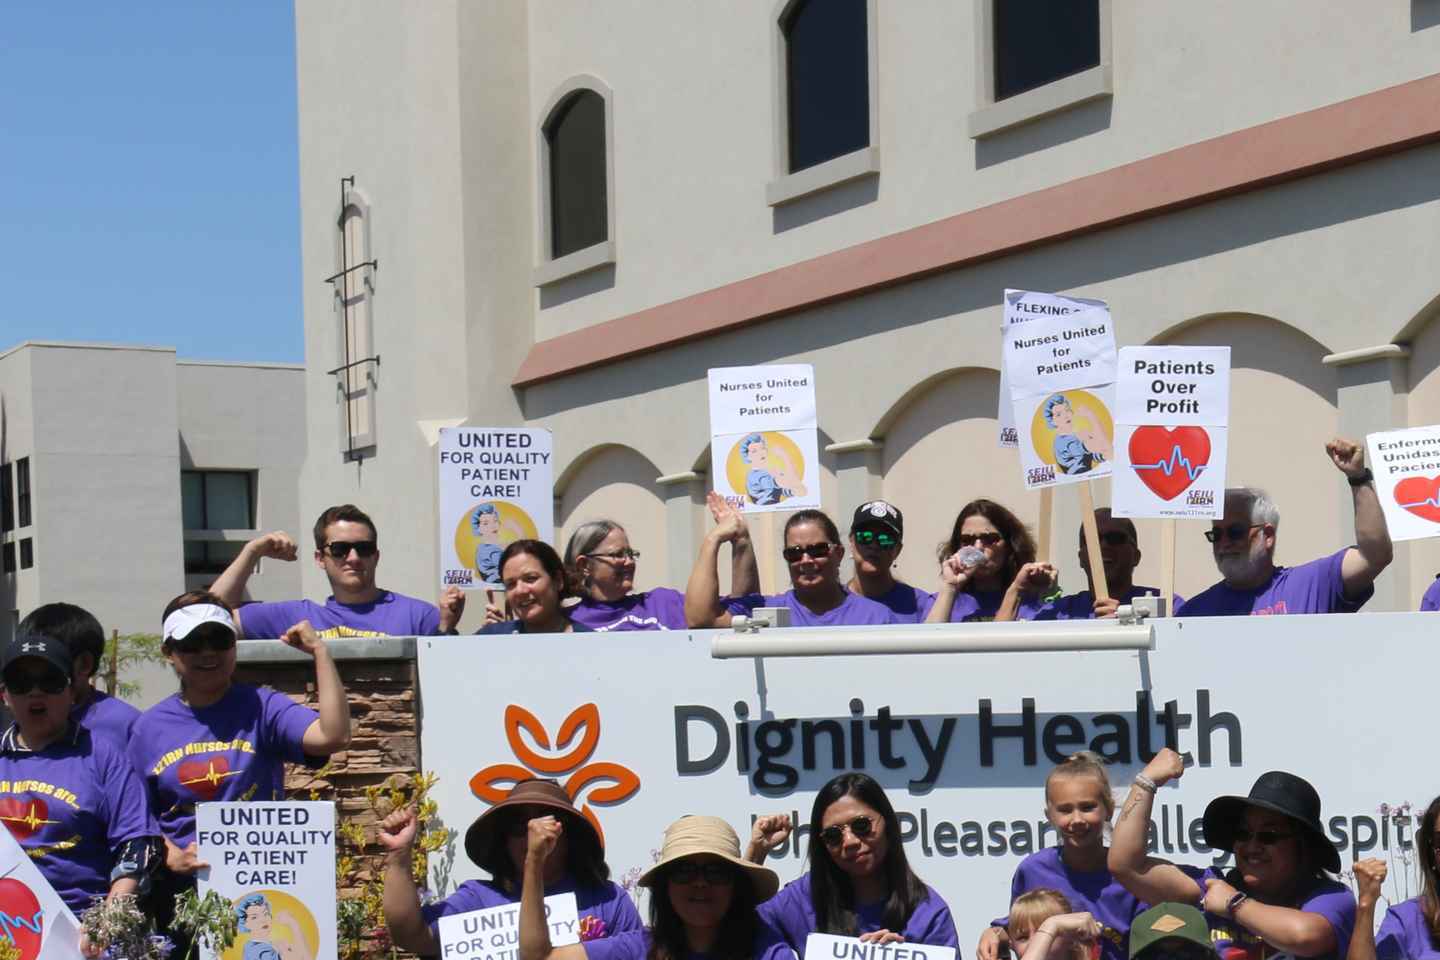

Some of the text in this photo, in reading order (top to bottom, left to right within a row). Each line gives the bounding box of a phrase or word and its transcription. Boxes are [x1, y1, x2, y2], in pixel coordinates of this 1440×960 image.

[1014, 325, 1106, 350] Nurses United
[1052, 348, 1070, 357] for
[1037, 359, 1091, 376] Patients
[1134, 360, 1215, 375] Patients
[720, 378, 808, 392] Nurses United
[1151, 380, 1197, 394] Over
[756, 394, 774, 402] for
[740, 406, 791, 416] Patients
[1146, 399, 1199, 414] Profit
[459, 433, 531, 448] UNITED
[441, 452, 551, 466] FOR QUALITY
[1383, 450, 1440, 463] Unidas
[462, 469, 530, 481] PATIENT
[471, 485, 521, 497] CARE!
[673, 689, 1243, 796] Dignity Health
[13, 780, 53, 796] Nurses
[220, 808, 309, 825] UNITED
[199, 831, 332, 846] FOR QUALITY
[899, 810, 1059, 857] Pleasan
[224, 850, 308, 865] PATIENT
[235, 871, 296, 885] CARE!
[463, 904, 551, 934] UNITD
[444, 920, 576, 958] FOR QUTY
